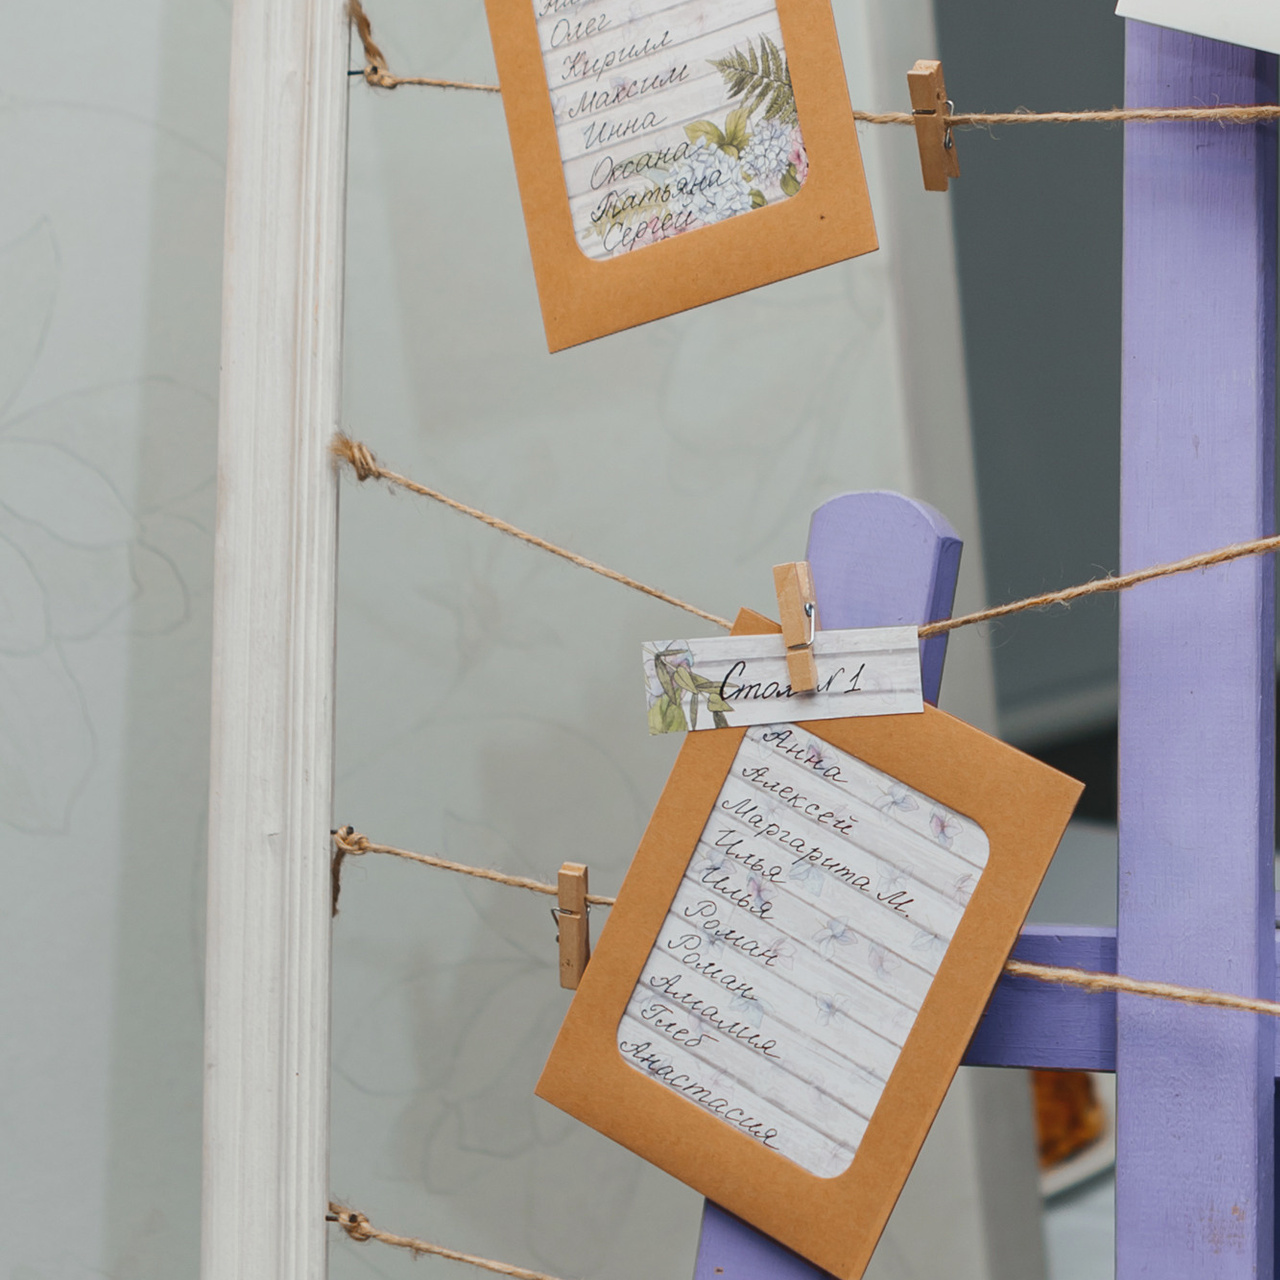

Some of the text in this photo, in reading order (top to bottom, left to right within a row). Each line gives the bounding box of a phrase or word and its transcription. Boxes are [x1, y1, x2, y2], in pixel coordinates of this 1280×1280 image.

[550, 13, 612, 48] Олег
[561, 30, 672, 83] Кирилл
[568, 64, 690, 119] Максим
[583, 111, 667, 150] Инна
[590, 140, 705, 191] Оксана
[590, 169, 731, 222] Татьяна
[602, 202, 698, 252] Сергей
[719, 660, 798, 702] Стол
[843, 663, 866, 694] 1
[762, 729, 848, 783] Анна
[742, 766, 859, 835] Алексей
[714, 829, 787, 884] Илья
[721, 798, 915, 918] Маргарита М.
[700, 866, 774, 920] Илья
[684, 900, 779, 967] Роман
[667, 933, 758, 1001] Роман
[640, 1003, 720, 1047] Глеб
[650, 974, 781, 1059] Амалия
[619, 1040, 780, 1150] Анастасия
